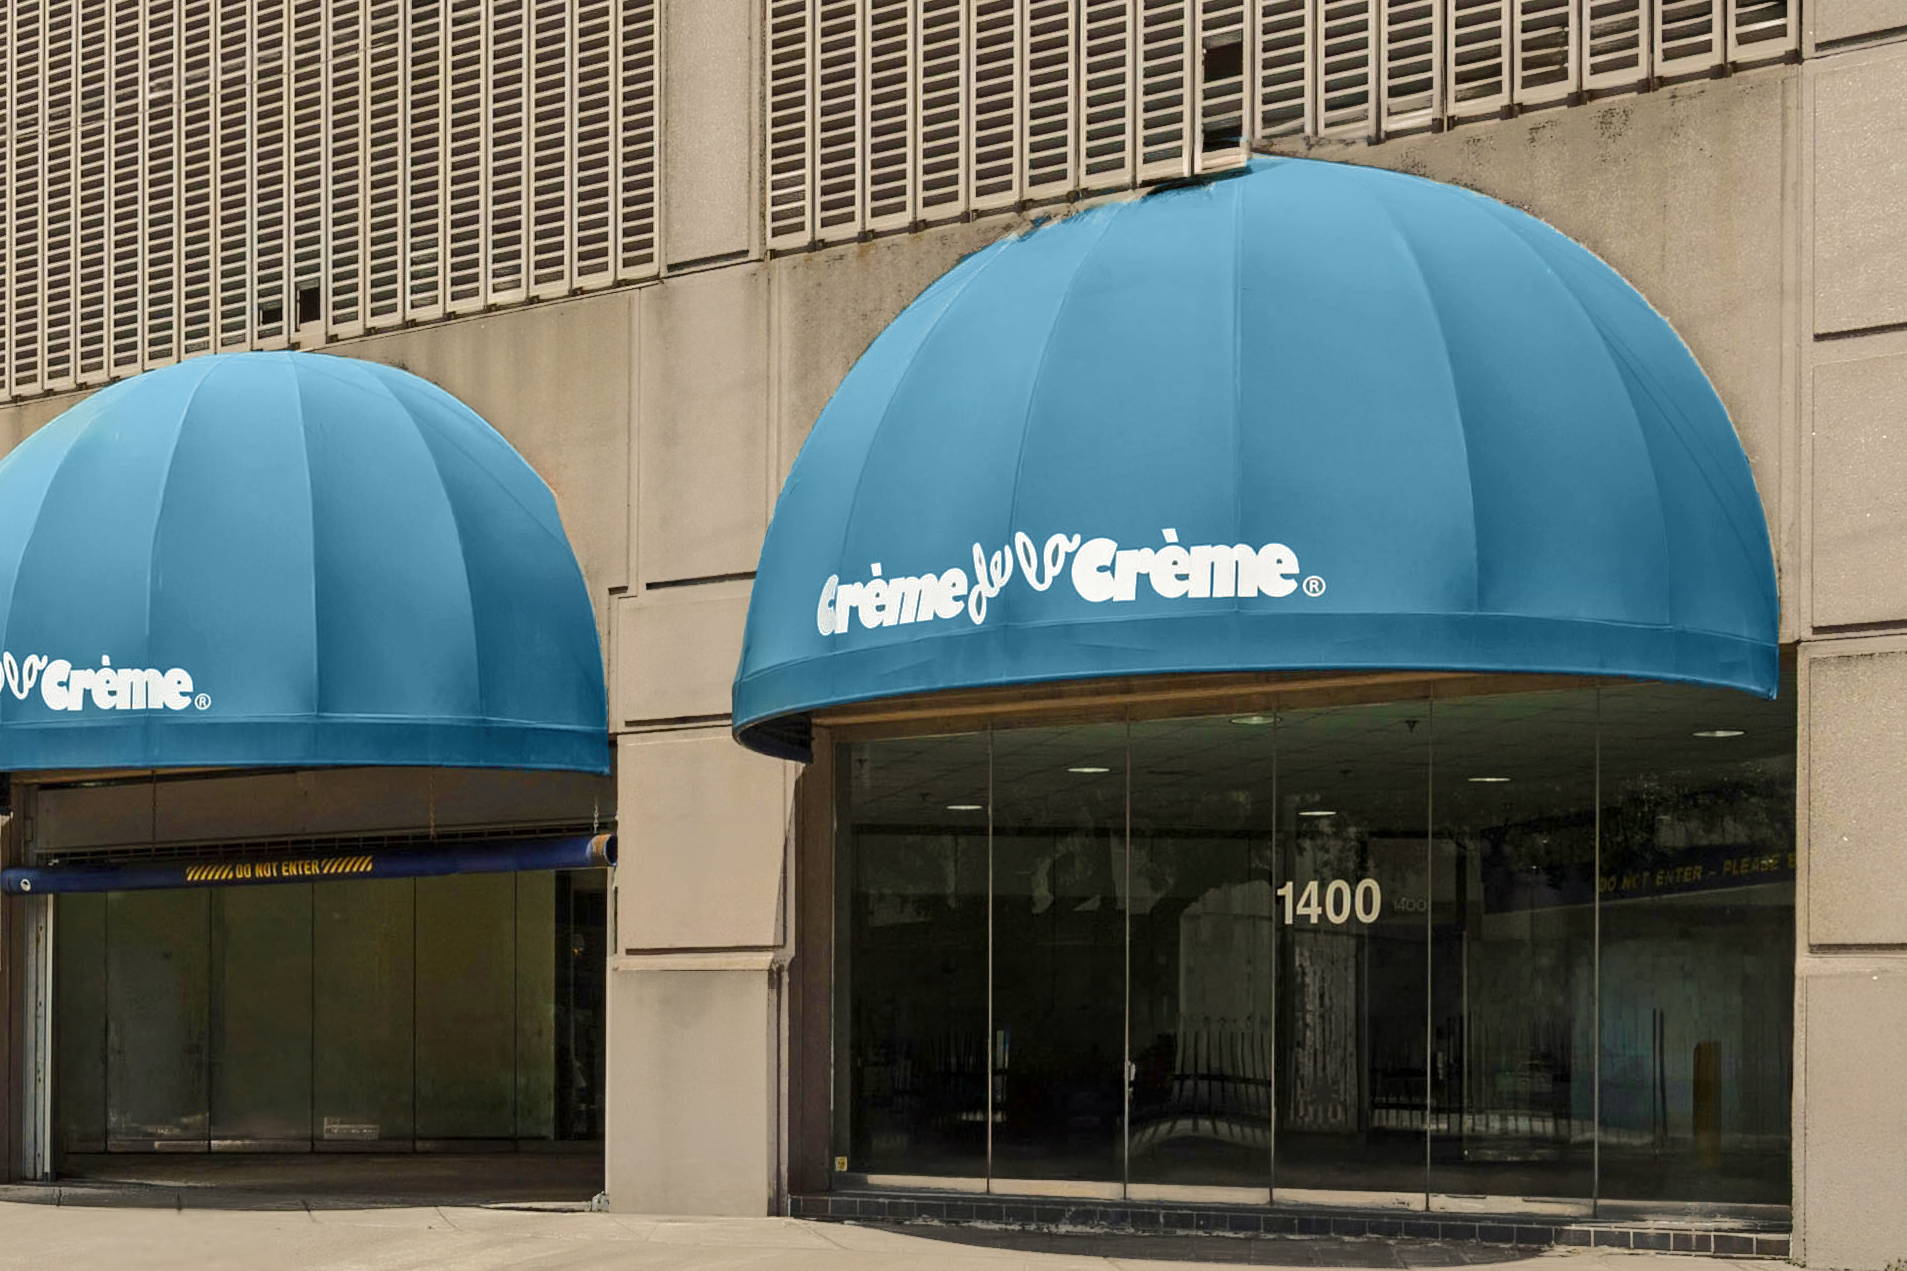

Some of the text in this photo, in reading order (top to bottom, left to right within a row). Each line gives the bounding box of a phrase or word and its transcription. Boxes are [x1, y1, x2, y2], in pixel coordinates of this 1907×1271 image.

[967, 542, 1014, 625] de
[1014, 531, 1081, 591] la
[235, 860, 320, 879] DO NOT ENTER
[1654, 865, 1702, 887] ENTER
[1721, 853, 1780, 878] PLEASE
[1276, 877, 1382, 925] 1400
